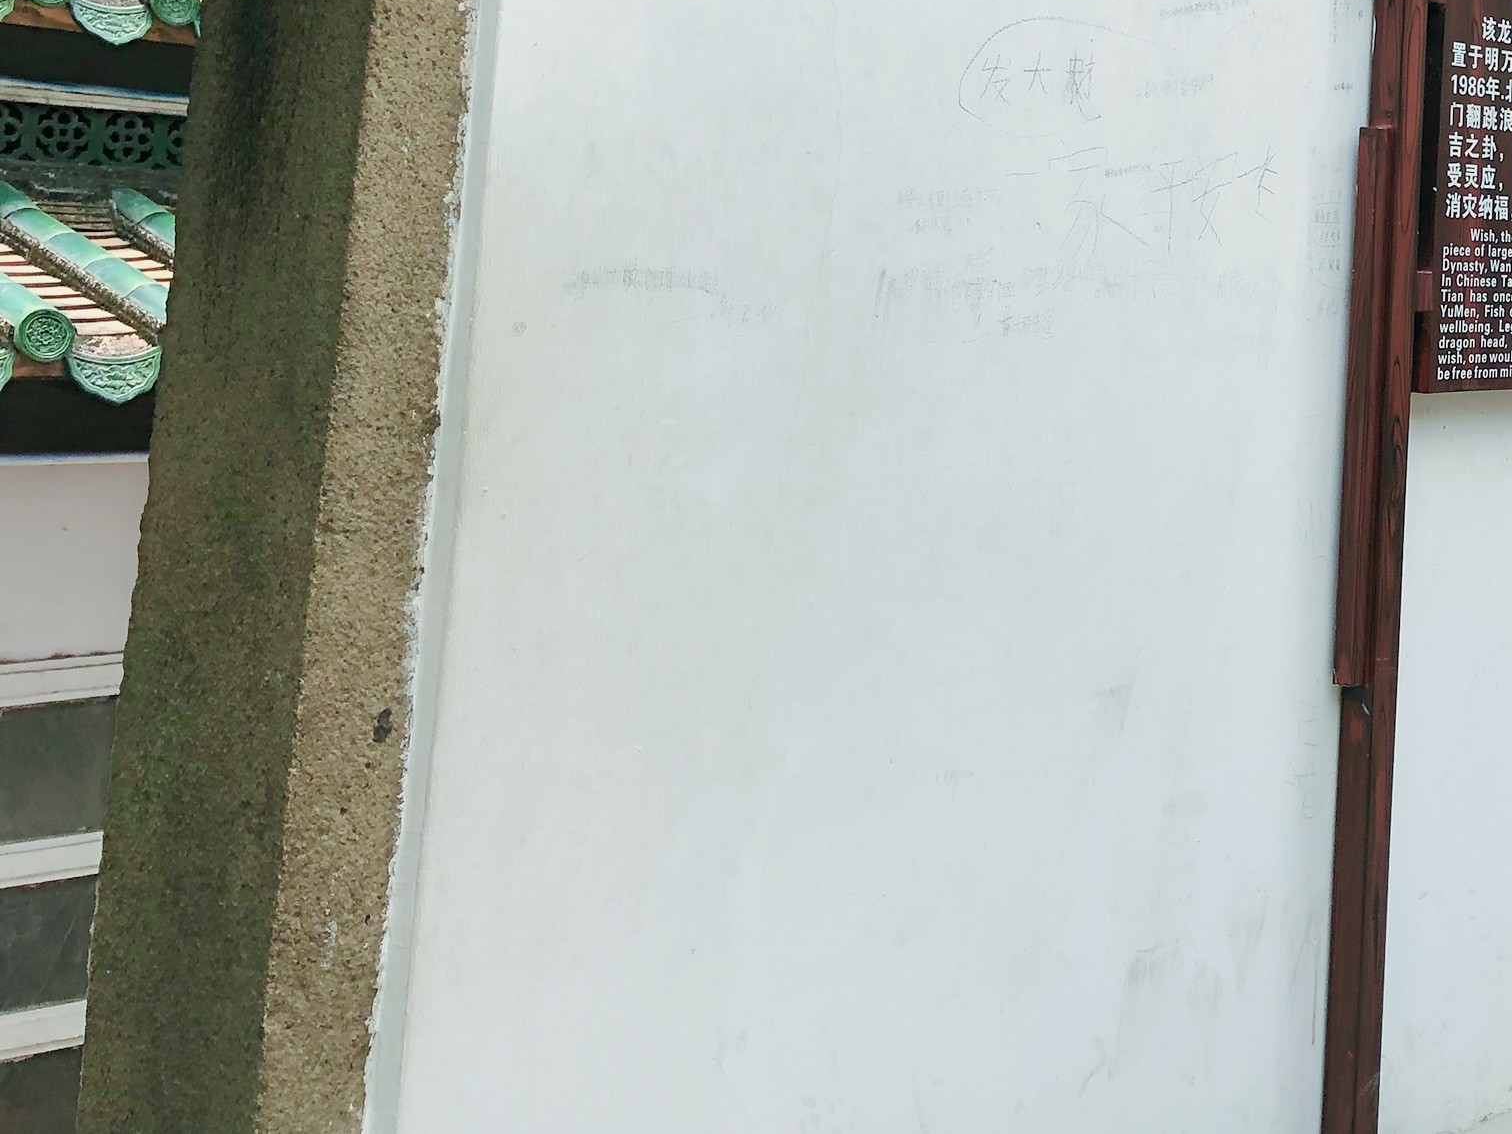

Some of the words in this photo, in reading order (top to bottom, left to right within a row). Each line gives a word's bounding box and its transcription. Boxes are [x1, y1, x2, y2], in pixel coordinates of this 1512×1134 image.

[1470, 228, 1498, 243] Wish,
[1443, 243, 1471, 258] piece
[1475, 244, 1485, 257] of
[1488, 245, 1512, 260] large
[1442, 258, 1488, 274] Dynasty,
[1441, 274, 1451, 286] In
[1457, 274, 1497, 287] Chinese
[1440, 289, 1463, 302] Tian
[1470, 290, 1487, 302] has
[1440, 305, 1480, 318] YuMen,
[1484, 305, 1505, 317] Fish
[1440, 320, 1494, 335] wellbeing.
[1438, 336, 1475, 351] dragon
[1480, 335, 1508, 348] head,
[1437, 351, 1466, 365] wish,
[1469, 353, 1487, 363] one
[1437, 367, 1450, 380] be
[1452, 366, 1472, 379] free
[1474, 366, 1497, 379] from
